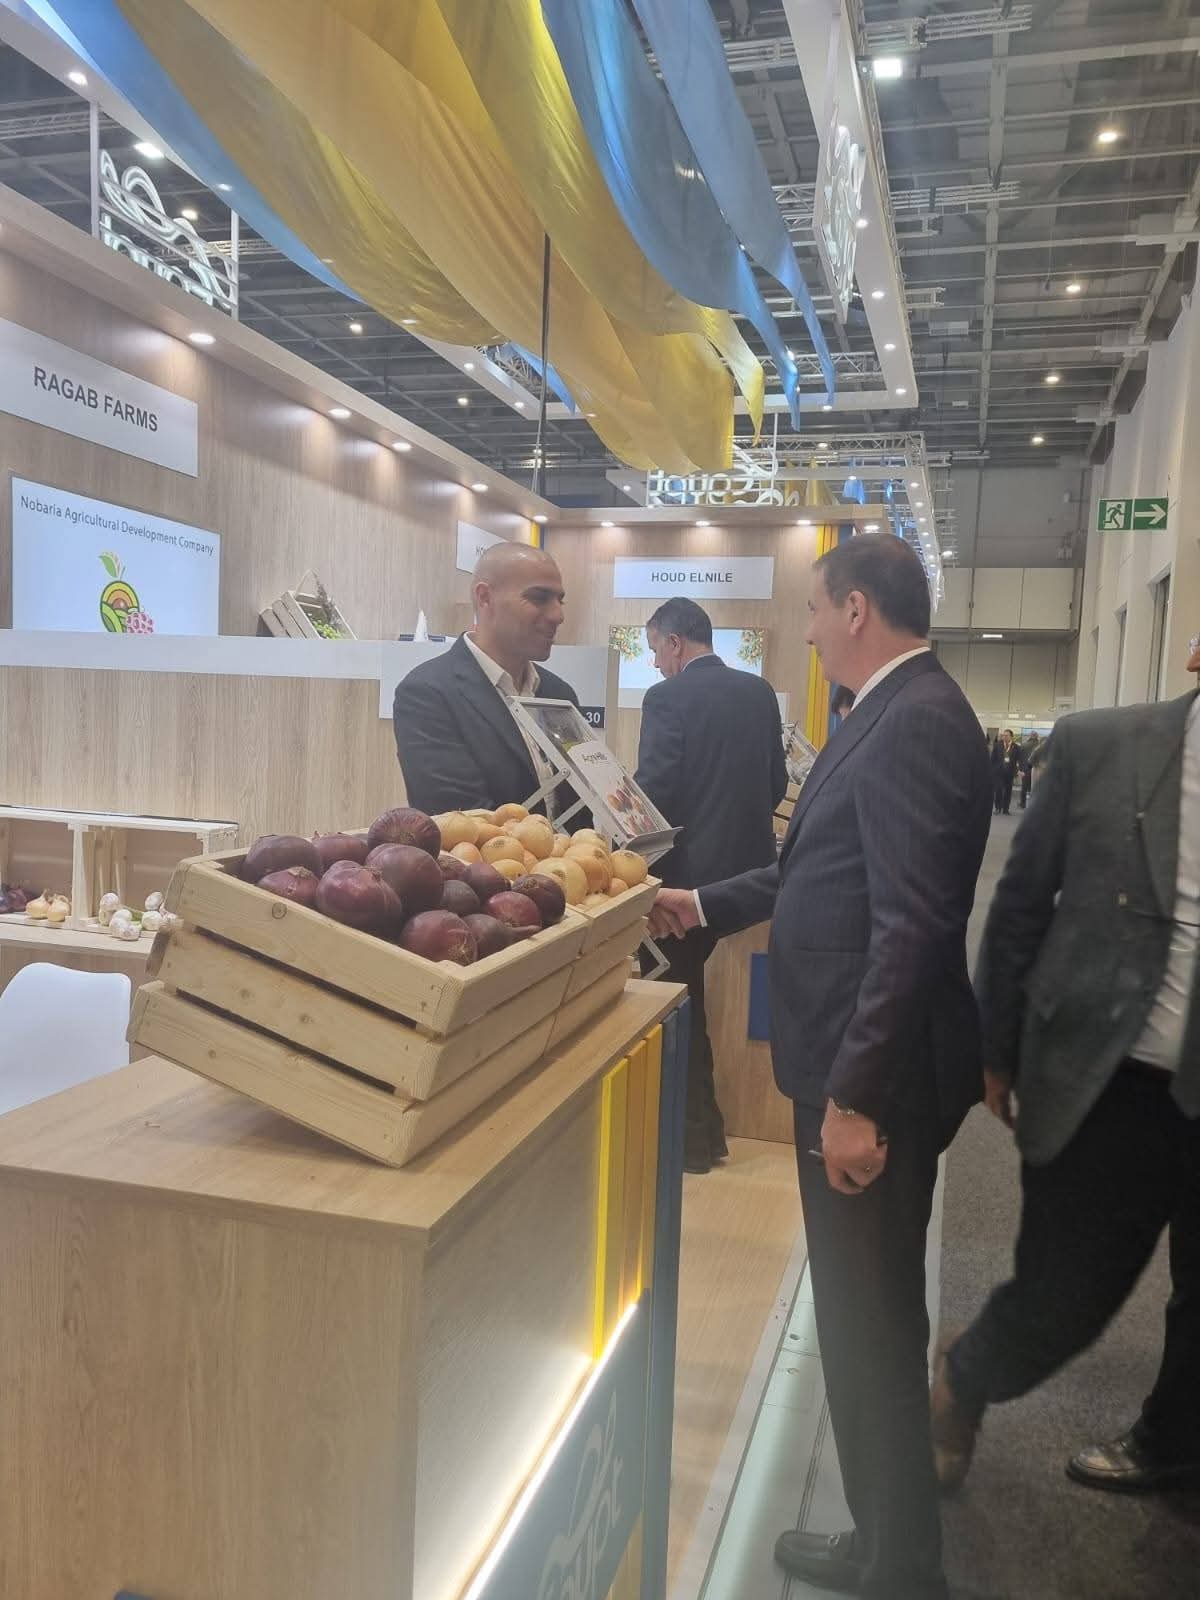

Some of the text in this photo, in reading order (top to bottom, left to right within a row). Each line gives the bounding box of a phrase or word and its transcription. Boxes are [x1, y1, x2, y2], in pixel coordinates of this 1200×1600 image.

[33, 365, 159, 433] RAGAB FARMS
[20, 495, 215, 557] Nobaria Agricultural Development Company
[651, 571, 734, 583] HOUD ELNILE
